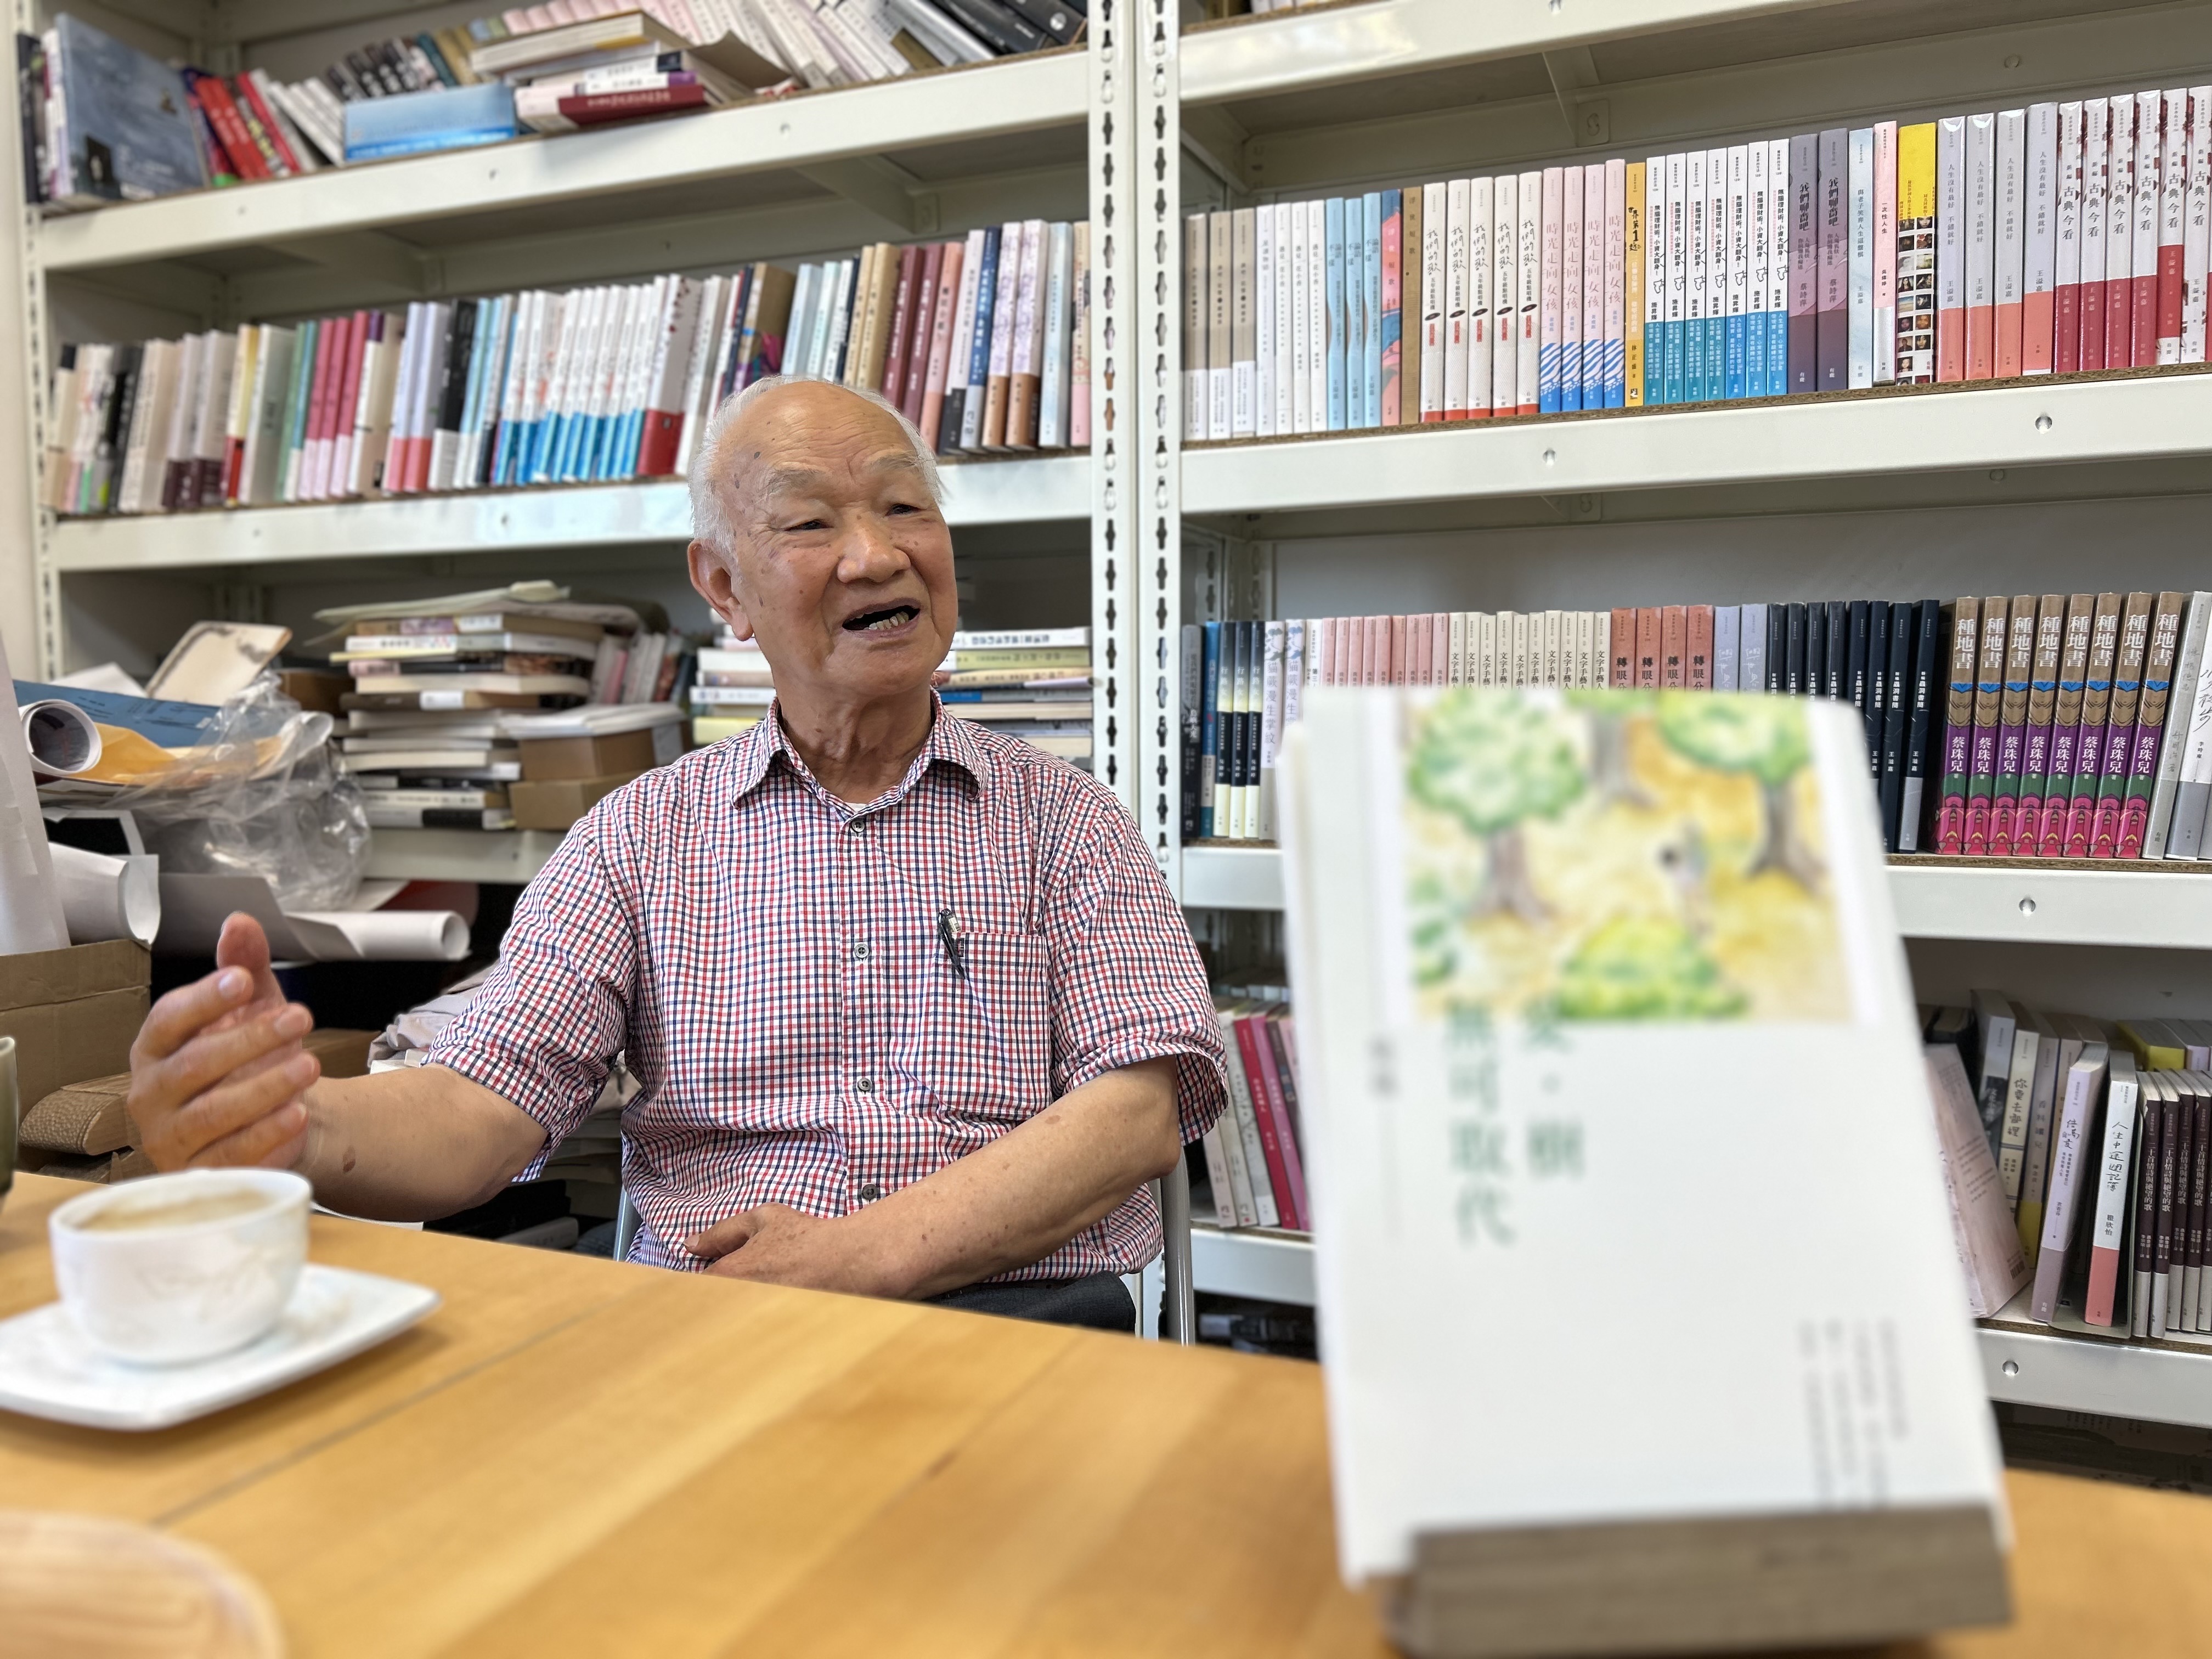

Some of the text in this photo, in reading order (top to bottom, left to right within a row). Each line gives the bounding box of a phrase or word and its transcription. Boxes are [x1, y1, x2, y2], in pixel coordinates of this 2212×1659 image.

[1829, 177, 1839, 226] 我們聊齋吧
[1426, 228, 1442, 275] 我們的歌
[1451, 225, 1466, 272] 我們的歌
[1474, 223, 1489, 270] 我們的歌
[1498, 222, 1513, 269] 我們的歌
[1521, 218, 1538, 266] 我們的歌
[1946, 216, 1955, 246] 不錯就好
[1546, 222, 1559, 310] 時光走向女孩
[1566, 221, 1579, 309] 時光走向女孩
[1588, 219, 1600, 308] 時光走向女孩
[1609, 215, 1621, 304] 時光走向女孩
[1954, 618, 1976, 669] 種地書
[1983, 617, 2004, 669] 種地書
[2011, 617, 2033, 668] 種地書
[2038, 616, 2061, 668] 種地書
[2066, 616, 2089, 667] 種地書
[2093, 615, 2117, 667] 種地書
[2122, 614, 2146, 667] 種地書
[2153, 614, 2178, 667] 種地書
[1265, 661, 1279, 745] 貓蕨漫生掌紋
[1950, 736, 1965, 772] 蔡珠兒
[1976, 737, 1992, 774] 蔡珠兒
[2003, 736, 2018, 773] 蔡珠兒
[2029, 736, 2045, 772] 蔡珠兒
[2055, 737, 2070, 774] 蔡珠兒
[2081, 737, 2098, 773] 蔡珠兒
[2109, 737, 2125, 774] 蔡珠兒
[2137, 737, 2154, 774] 蔡珠兒
[2007, 1079, 2028, 1137] 你要去哪裡
